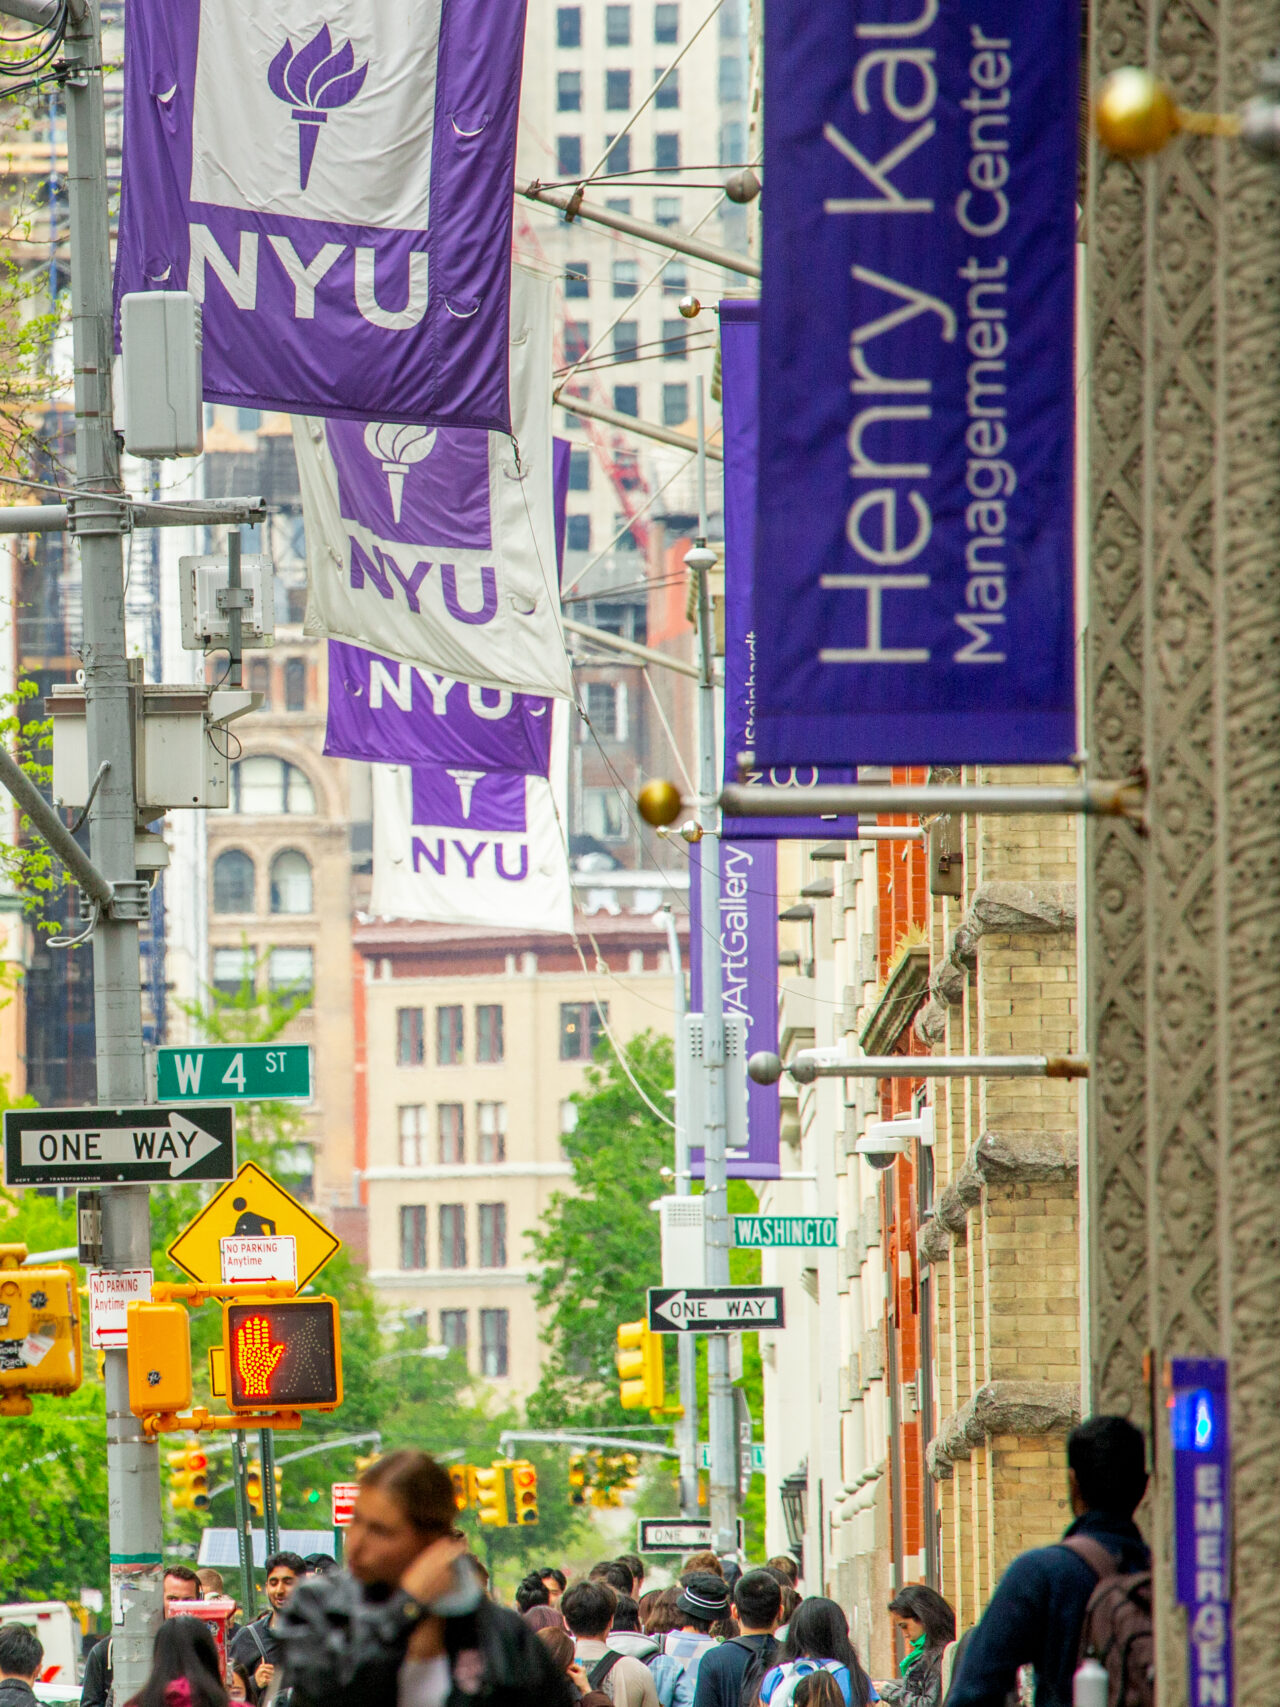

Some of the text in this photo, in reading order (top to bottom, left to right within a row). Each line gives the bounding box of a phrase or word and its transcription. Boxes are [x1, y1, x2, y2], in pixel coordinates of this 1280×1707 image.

[188, 223, 429, 330] NYU
[954, 24, 1017, 663] Management Center
[819, 265, 957, 662] Henry
[349, 535, 499, 625] NYU
[369, 660, 514, 720] NYU
[411, 836, 529, 881] NYU
[174, 1052, 288, 1094] W 4 ST
[39, 1131, 199, 1162] ONE WAY
[227, 1242, 278, 1253] NO PARKING
[737, 1219, 839, 1246] WASHINGTO
[227, 1256, 263, 1268] Anytime
[93, 1278, 139, 1294] NO PARKING
[94, 1298, 125, 1313] Anytime
[670, 1300, 767, 1318] ONE WAY
